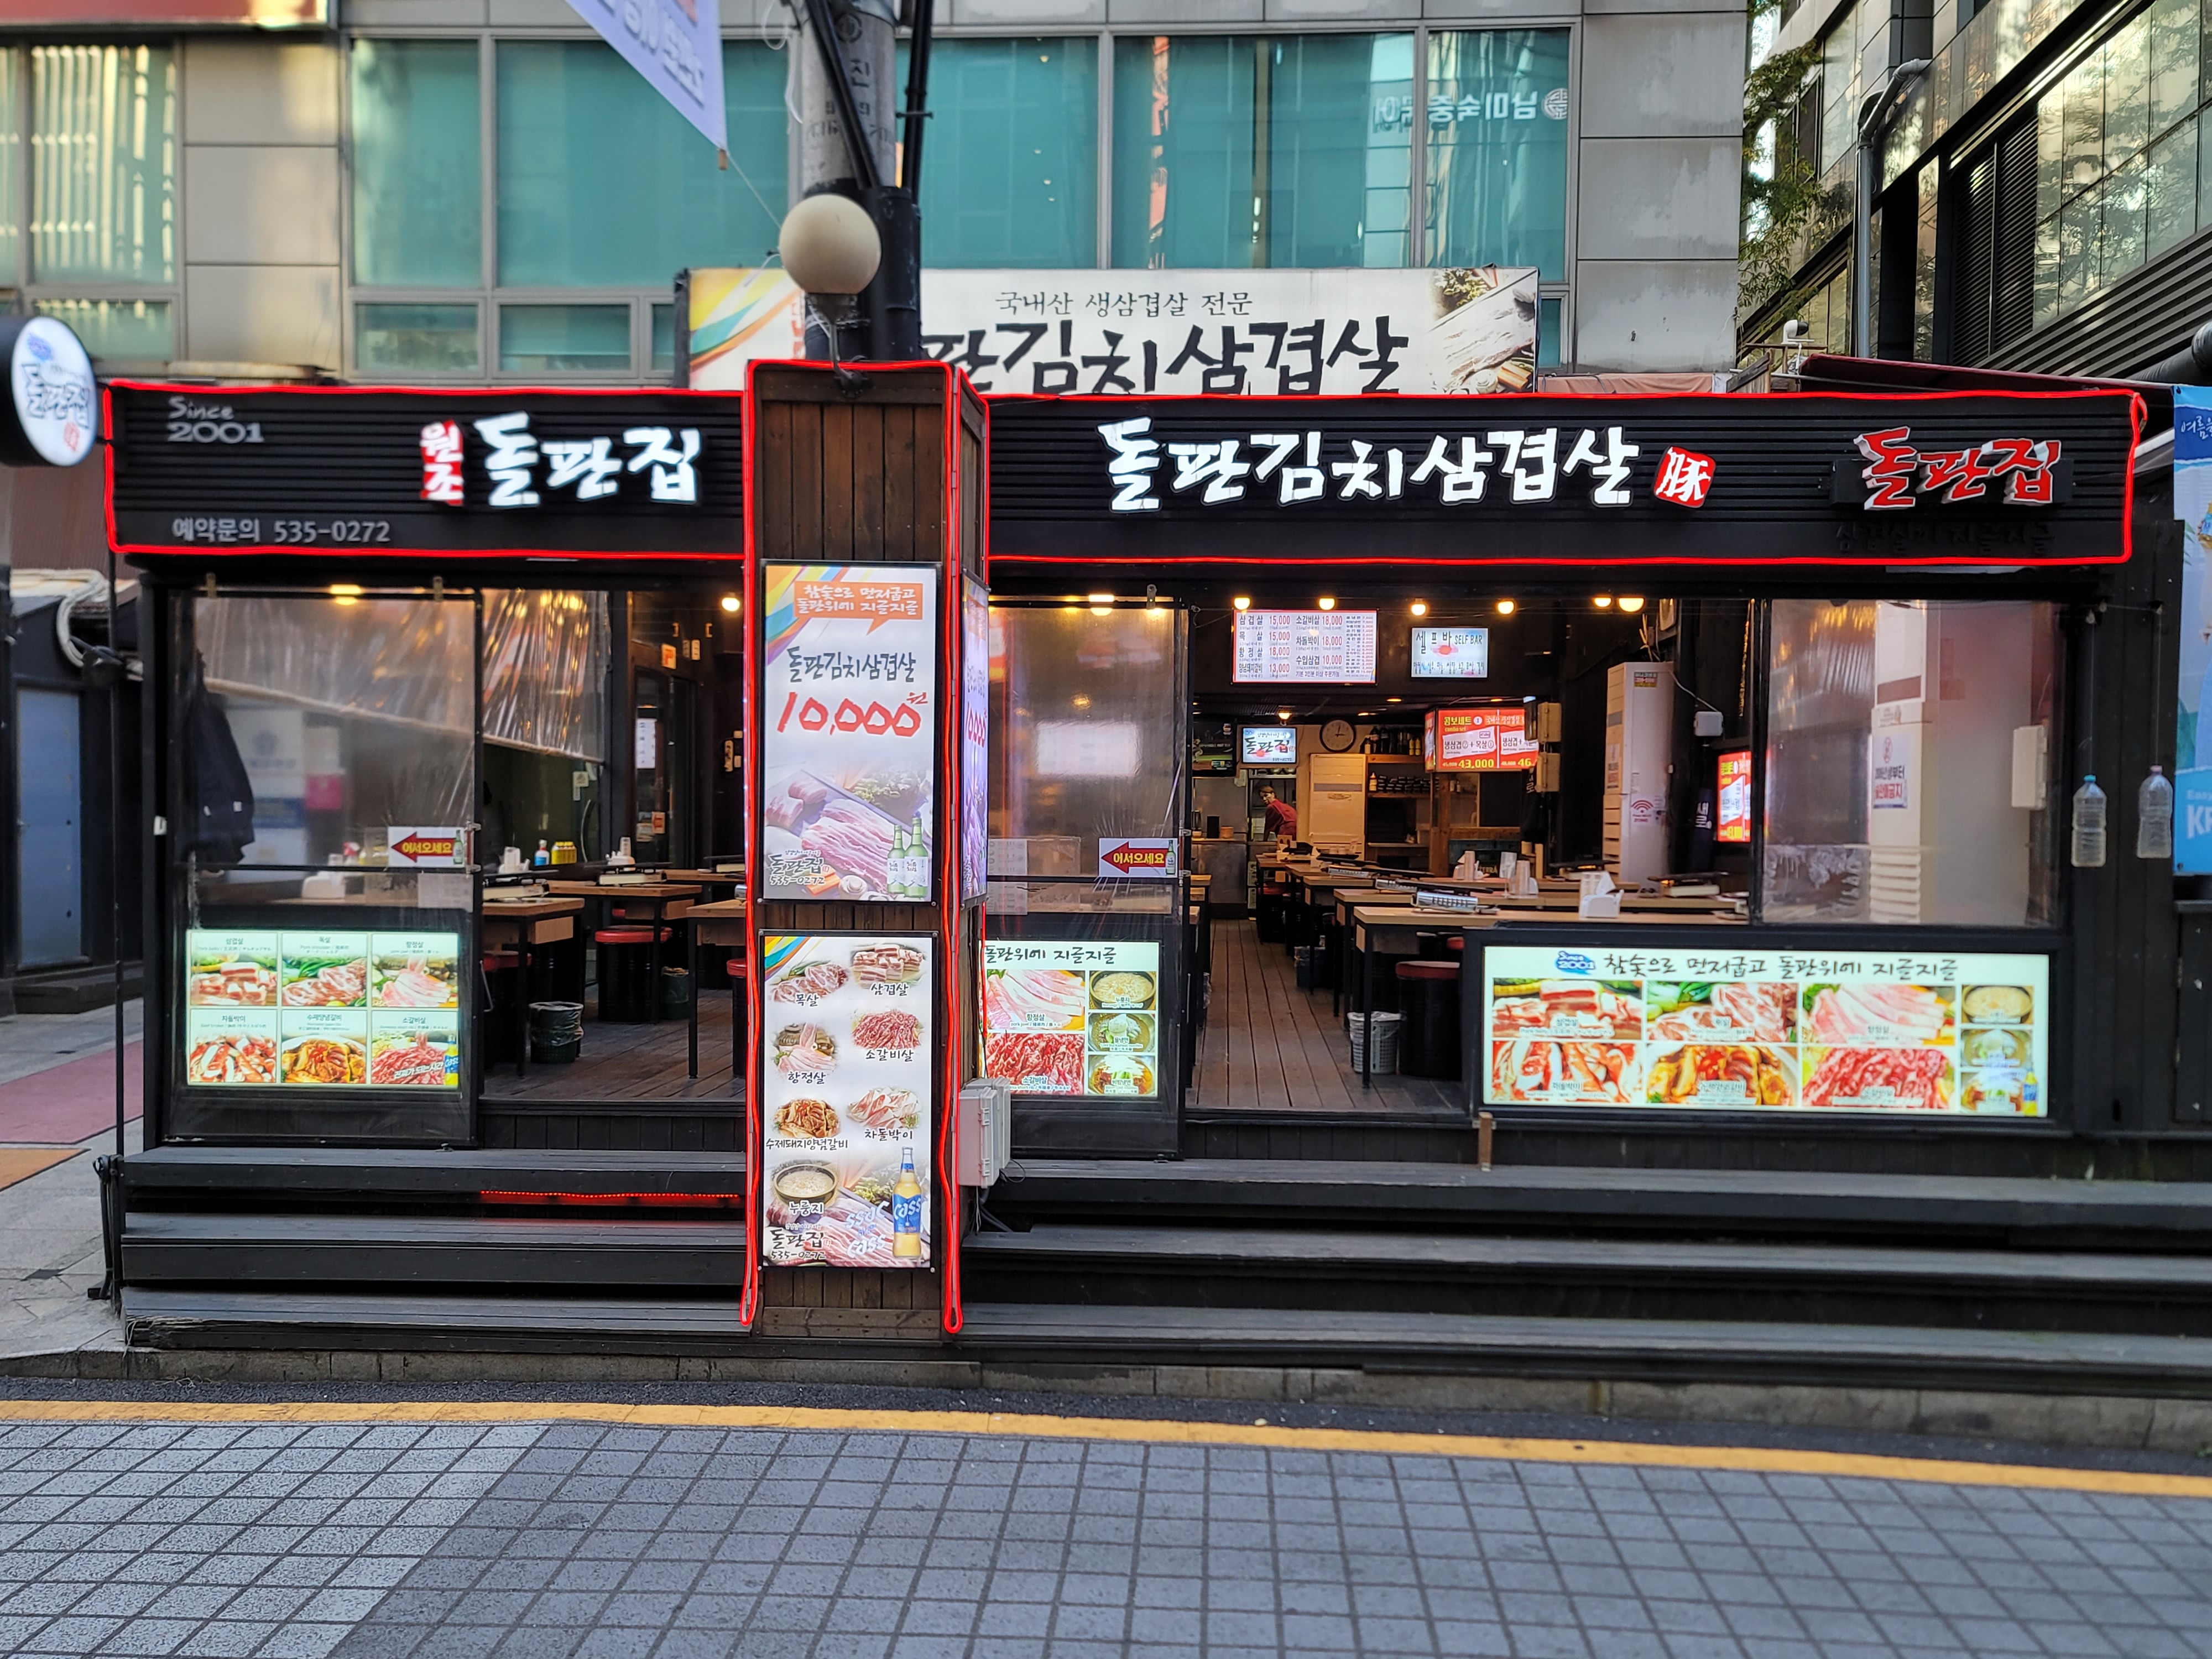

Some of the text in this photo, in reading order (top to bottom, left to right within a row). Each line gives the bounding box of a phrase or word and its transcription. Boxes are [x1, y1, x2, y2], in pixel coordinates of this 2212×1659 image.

[995, 291, 1253, 318] 국내산 생삼겹살 전문
[921, 315, 1409, 394] 판김치삼겹살
[168, 396, 234, 420] Since
[168, 422, 264, 443] 2001
[420, 421, 464, 502] 원조
[474, 411, 702, 508] 돌판집
[1098, 417, 1640, 512] 돌판김치삼겹살
[1854, 425, 2062, 510] 돌판집
[173, 518, 390, 543] 예약문의 535-0272
[803, 585, 915, 600] 참숯으로 먼저굽고
[1269, 615, 1290, 626] 15,000
[1296, 615, 1343, 626] 소갈비살 18,000
[1269, 632, 1290, 642] 15,000
[1322, 636, 1342, 646] 18,000
[1454, 635, 1469, 645] SELF
[1470, 635, 1483, 645] BAR
[1269, 647, 1290, 657] 18,000
[786, 646, 916, 682] 돌판김치삼겹살
[1296, 655, 1342, 665] 수입삼겹 10,000
[1269, 664, 1290, 674] 13,000
[777, 692, 921, 737] 10,000
[1458, 759, 1495, 768] 43,000
[402, 842, 452, 854] 어서오세요
[769, 854, 823, 874] 돌판집
[1113, 852, 1165, 864] 어서오세요
[770, 875, 825, 885] 535-0272
[1053, 946, 1117, 964] 지글지글
[1558, 961, 1595, 970] 2001
[1604, 954, 1676, 977] 참숯으로
[1687, 956, 1767, 978] 먼저굽고
[1873, 958, 1958, 980] 지글지글
[870, 983, 909, 996] 삼겹살
[795, 994, 819, 1006] 목살
[865, 1049, 914, 1062] 소갈비살
[788, 1072, 826, 1084] 항정살
[864, 1128, 913, 1141] 차돌박이
[766, 1138, 848, 1151] 수제돼지양념갈비
[789, 1201, 824, 1214] 누룽지
[770, 1229, 824, 1249] 돌판집
[771, 1250, 826, 1260] 535-0272
